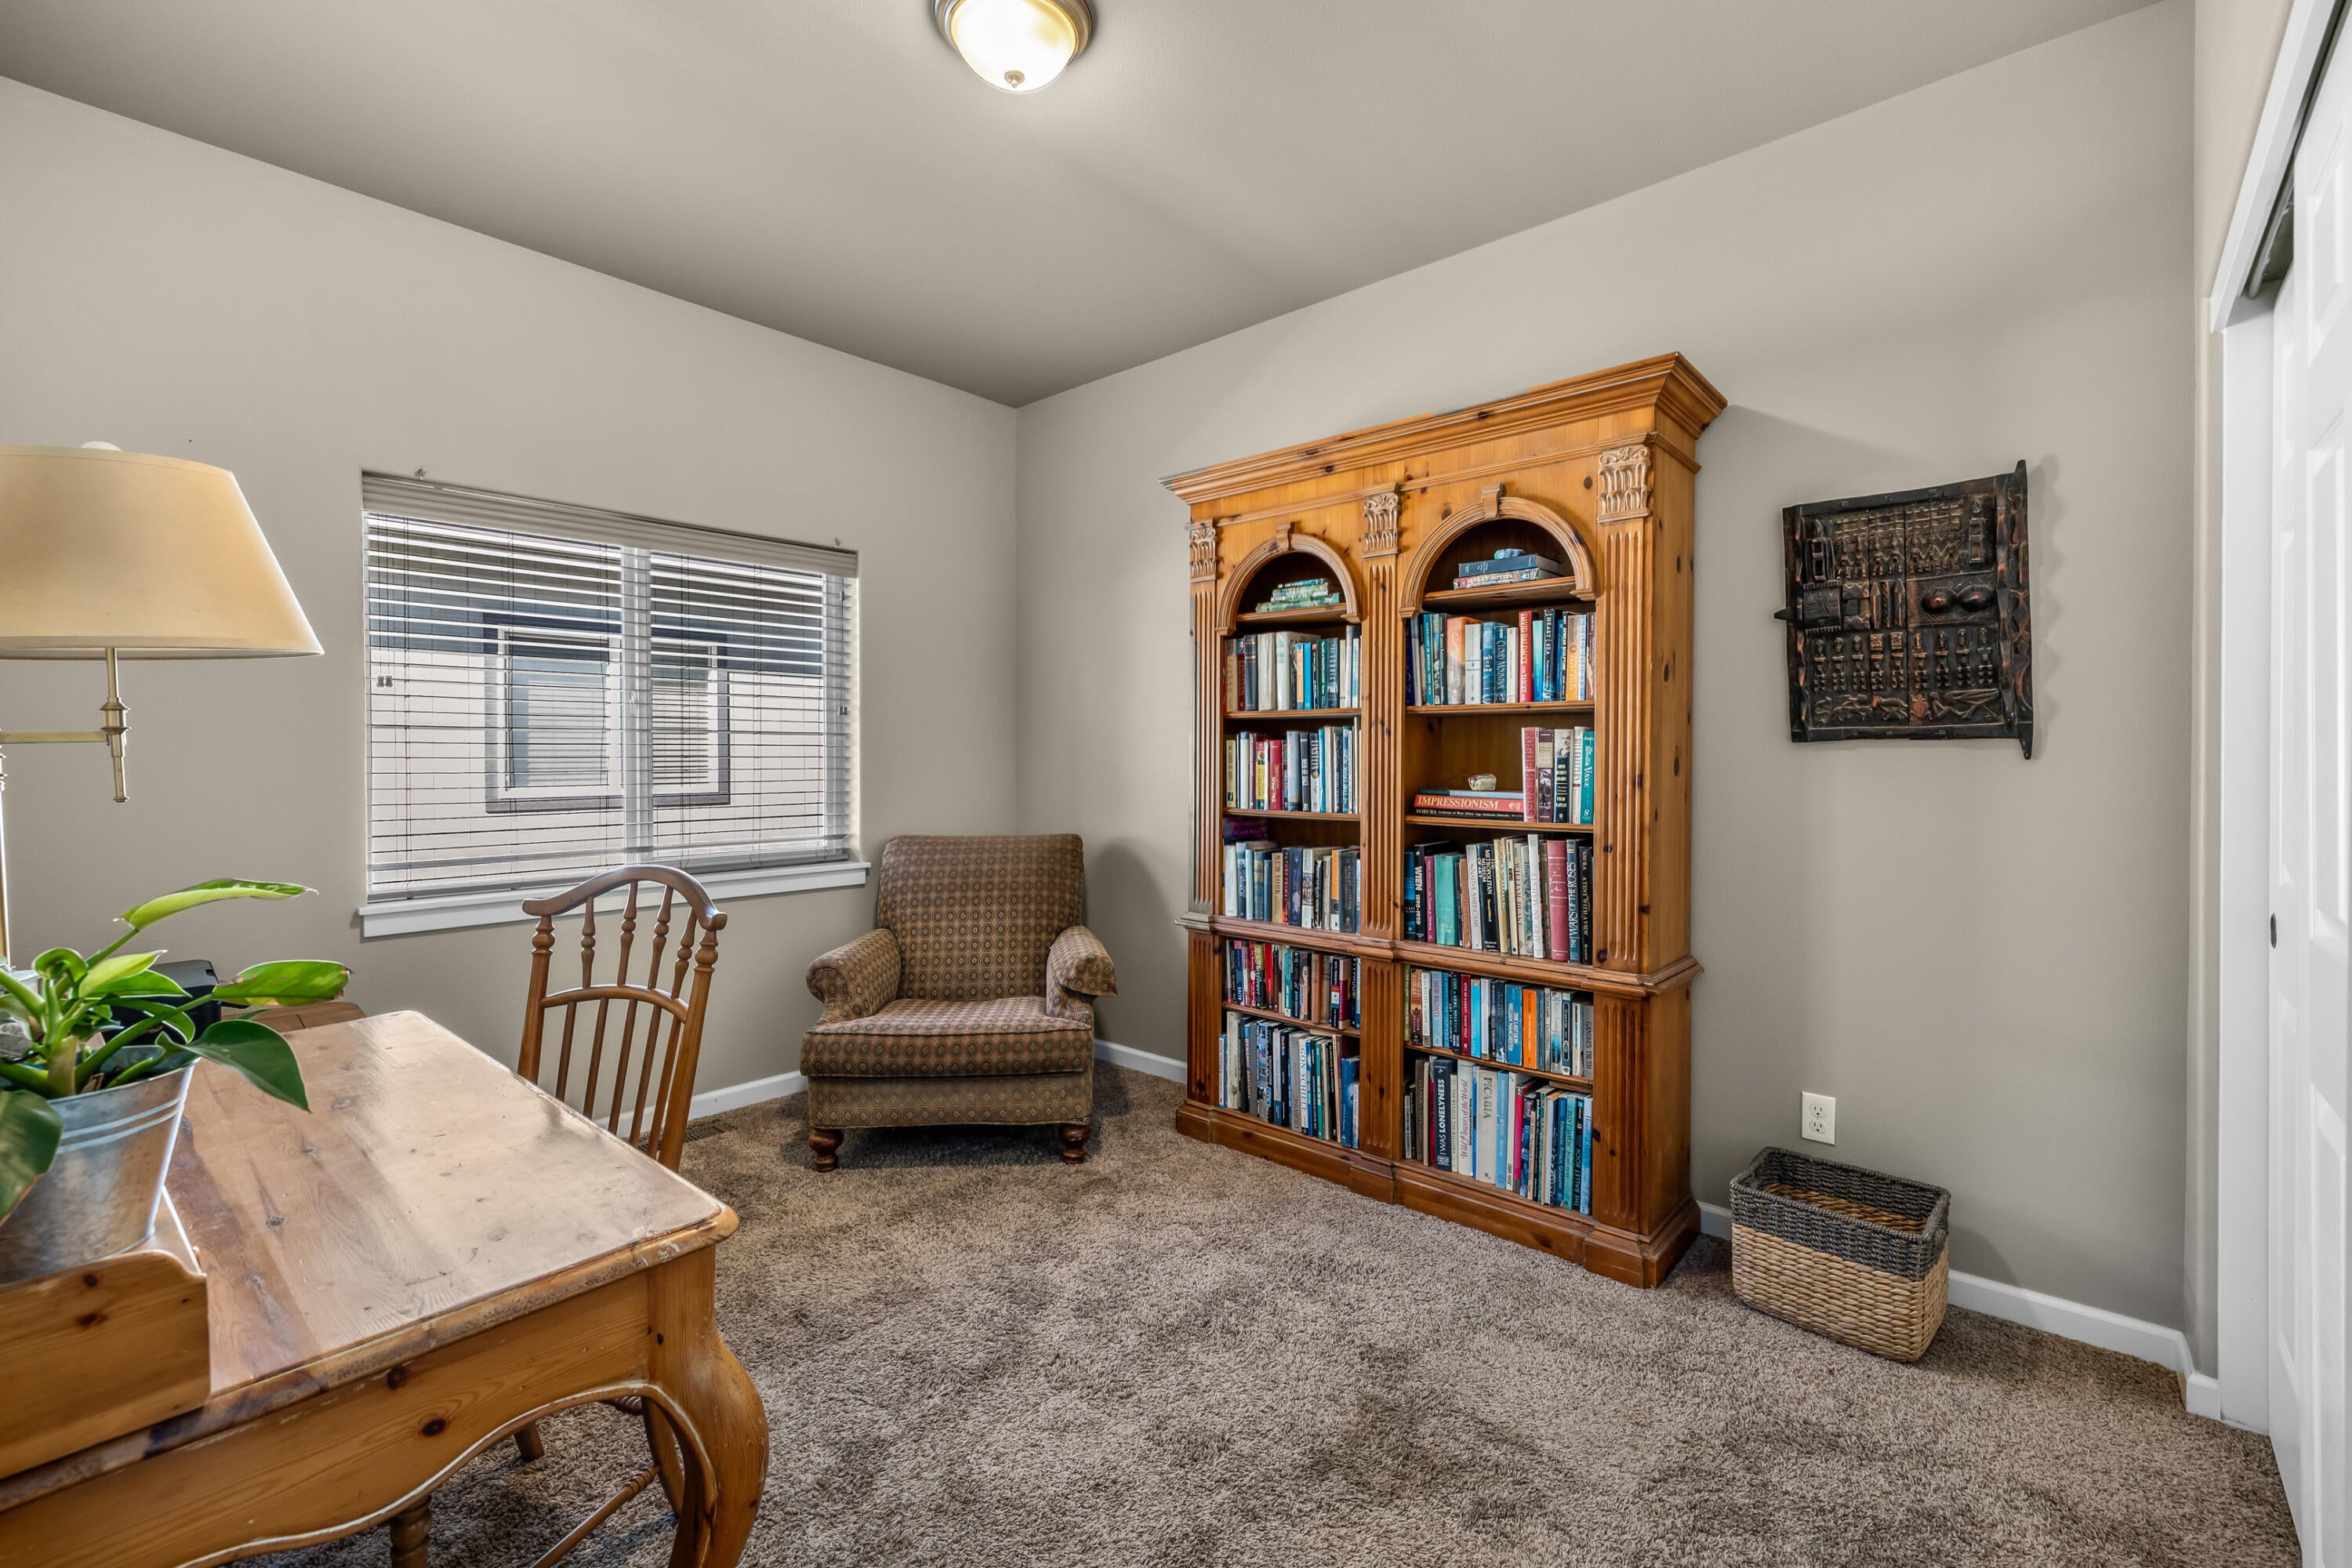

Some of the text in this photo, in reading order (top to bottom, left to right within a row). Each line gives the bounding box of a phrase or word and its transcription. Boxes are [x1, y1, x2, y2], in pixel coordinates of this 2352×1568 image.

[1497, 640, 1507, 689] CLOUD MOUNTAIN
[1311, 739, 1320, 771] EINSTEIN
[1526, 731, 1536, 816] ROGUE HEROES
[1417, 797, 1500, 810] IMPRESSIONISM
[1477, 858, 1482, 866] OF
[1484, 849, 1494, 895] METROPOLITAN
[1566, 861, 1577, 888] ROSES
[1414, 866, 1423, 891] WIEN
[1468, 869, 1477, 892] NATIVE
[1470, 892, 1479, 928] AMERICANS
[1568, 902, 1576, 911] OF
[1569, 910, 1578, 938] WARS
[1438, 1078, 1446, 1134] LONELYNESS
[1483, 1076, 1493, 1120] PICABIA
[1460, 1114, 1469, 1143] Flowers
[1584, 1115, 1592, 1135] History
[1461, 1141, 1469, 1160] Wild
